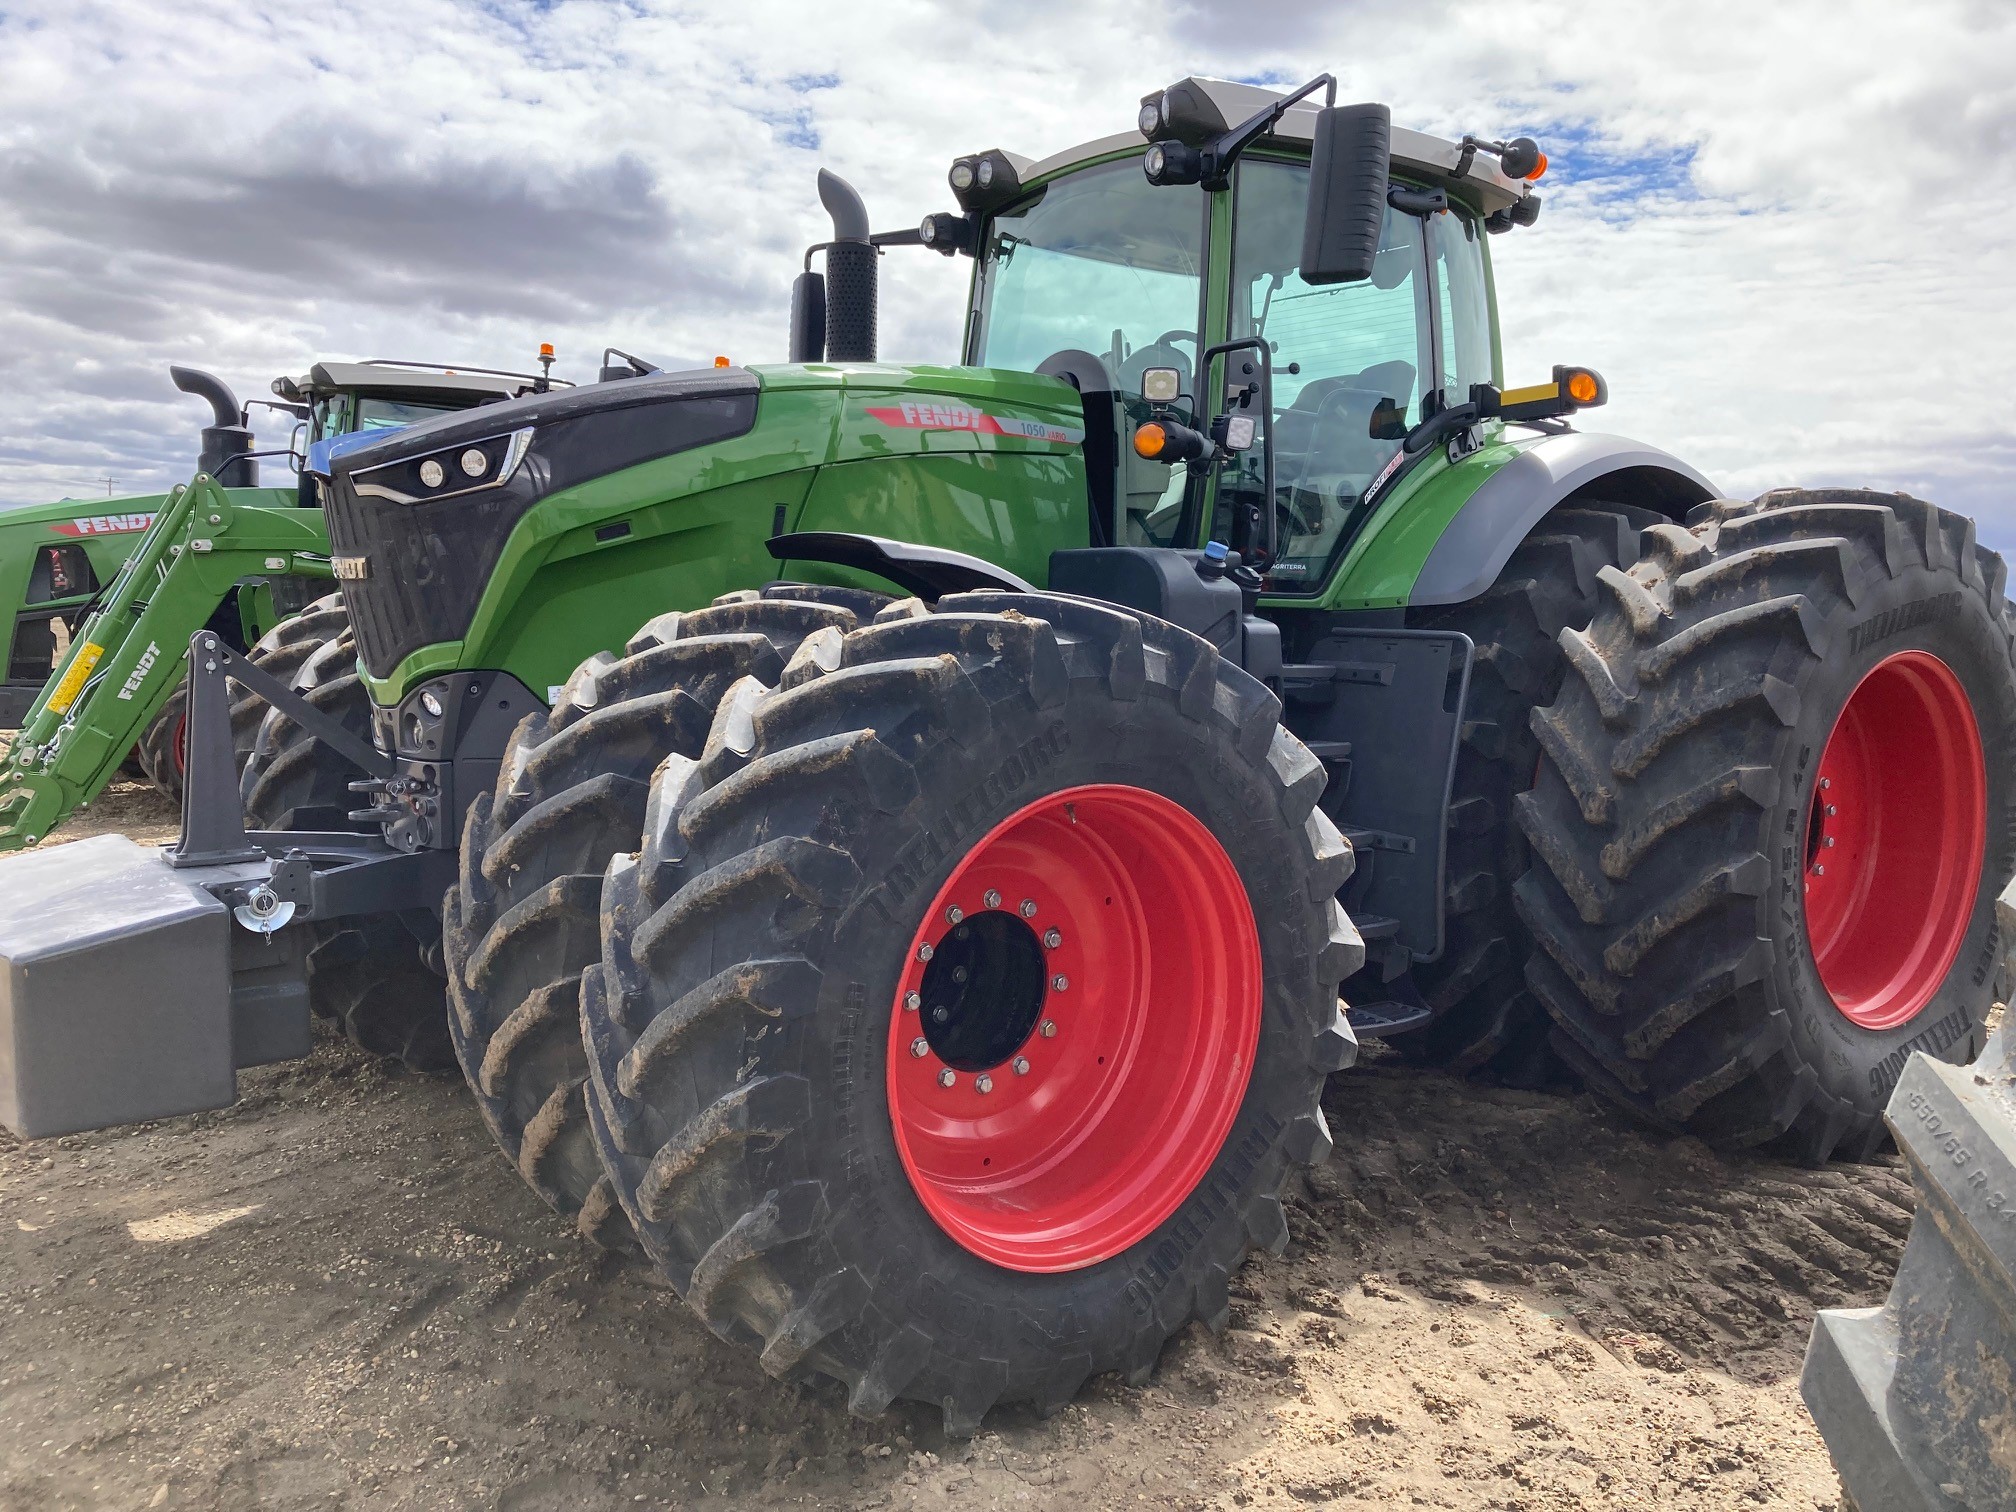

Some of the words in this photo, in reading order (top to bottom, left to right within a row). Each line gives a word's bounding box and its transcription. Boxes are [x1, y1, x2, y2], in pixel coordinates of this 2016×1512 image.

[900, 402, 983, 429] FENDT
[1020, 422, 1045, 437] 1050
[1271, 563, 1306, 571] AGRITERRA
[117, 641, 161, 700] FENDT
[864, 718, 1072, 928] TRELLEBORG
[832, 979, 867, 1142] POWER
[1909, 1094, 1972, 1168] 650/65
[1122, 1112, 1287, 1317] TRELLEBORG
